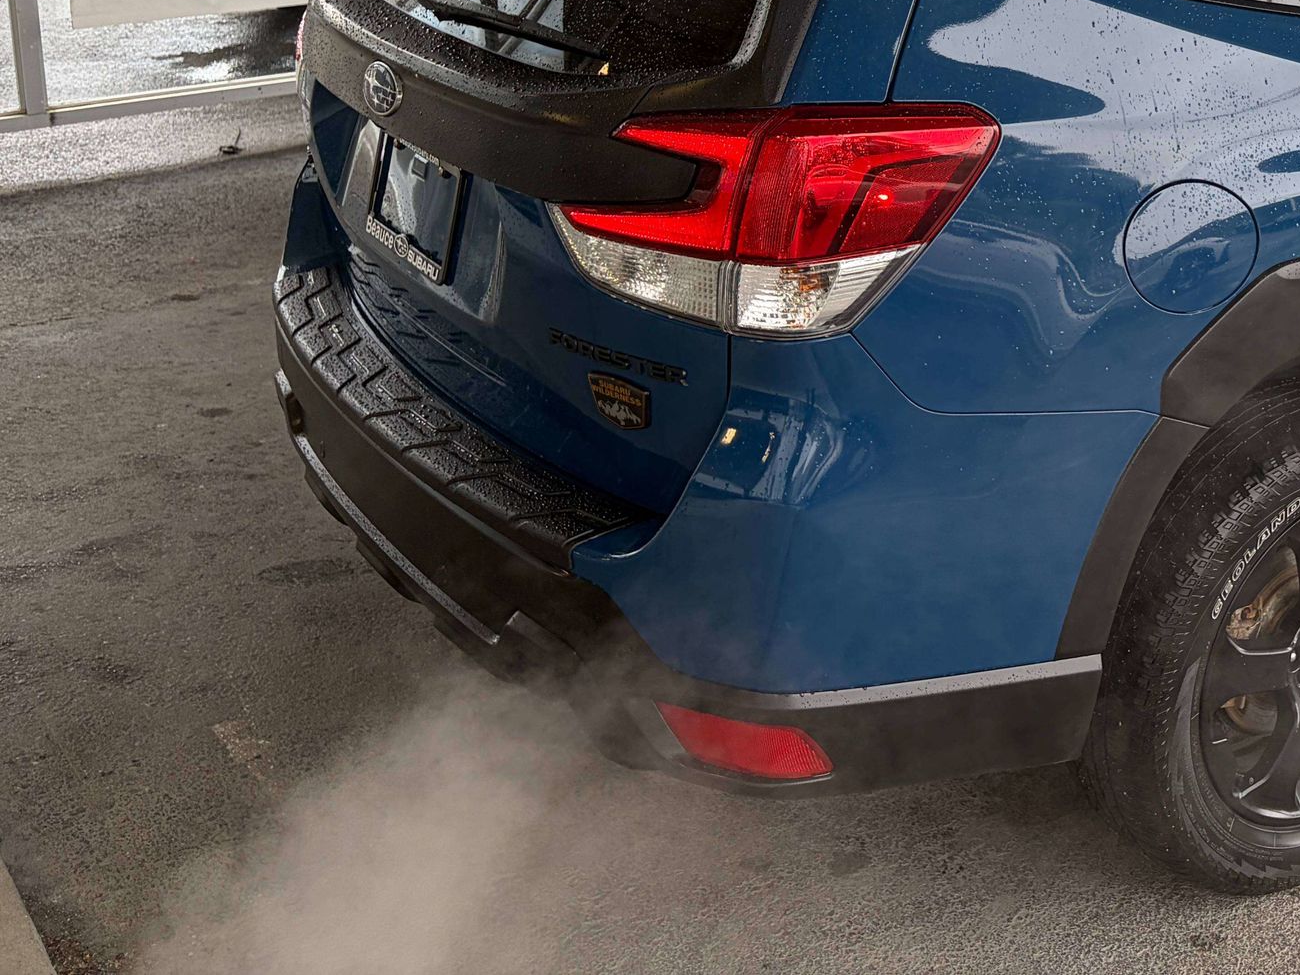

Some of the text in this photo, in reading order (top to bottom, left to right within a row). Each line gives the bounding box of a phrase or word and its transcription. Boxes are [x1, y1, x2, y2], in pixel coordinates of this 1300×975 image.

[366, 214, 439, 281] Beauce SUBARU
[549, 327, 689, 387] FORESTER
[592, 385, 643, 407] WILDERNESS
[599, 379, 631, 396] SUBARU
